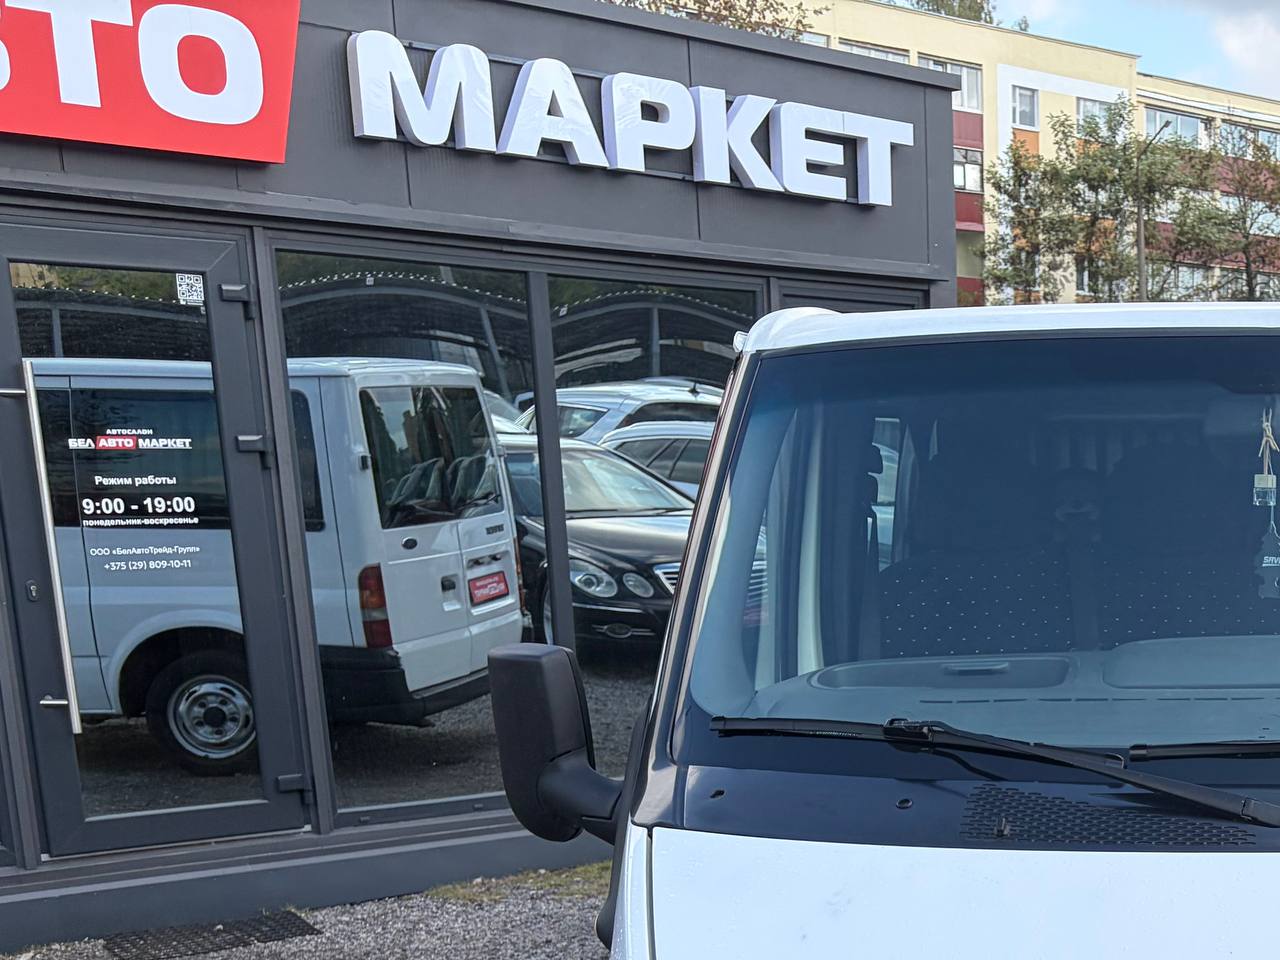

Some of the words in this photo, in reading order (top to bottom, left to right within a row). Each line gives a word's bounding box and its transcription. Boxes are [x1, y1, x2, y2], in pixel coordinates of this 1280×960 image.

[0, 0, 264, 125] ТО
[346, 29, 915, 206] МАРКЕТ
[68, 438, 95, 448] БЕЛ
[98, 438, 134, 448] АВТО
[138, 438, 192, 448] МАРКЕТ
[94, 475, 132, 486] Режим
[134, 475, 176, 486] работы
[82, 498, 125, 514] 9:00
[143, 496, 196, 513] 19:00
[104, 562, 127, 571] +375
[128, 560, 147, 570] (29)
[149, 559, 192, 569] 809-10-11
